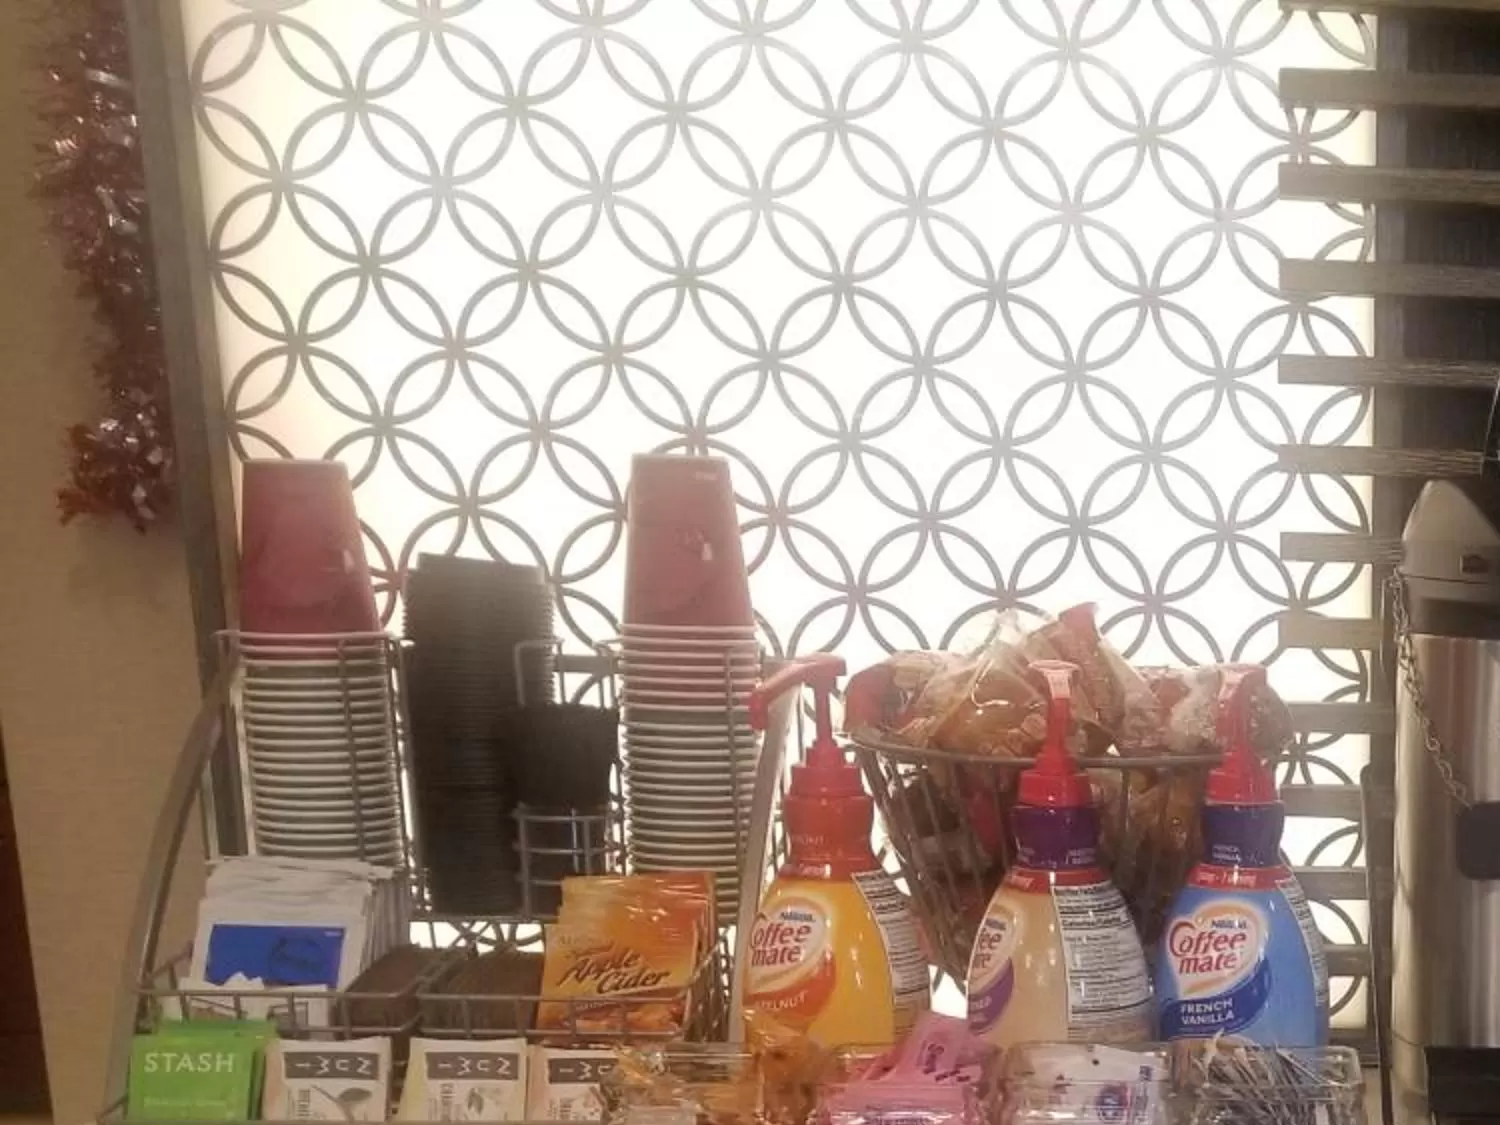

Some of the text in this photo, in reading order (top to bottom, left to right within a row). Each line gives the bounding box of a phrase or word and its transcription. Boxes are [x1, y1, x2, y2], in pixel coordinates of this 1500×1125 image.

[1169, 920, 1247, 958] Coffee
[556, 945, 642, 987] Apple
[752, 946, 801, 967] mate
[1179, 952, 1238, 975] mate
[596, 968, 671, 994] Cider
[1180, 998, 1234, 1014] FRENCH
[1180, 1010, 1235, 1026] VANILLA
[143, 1052, 234, 1073] STASH
